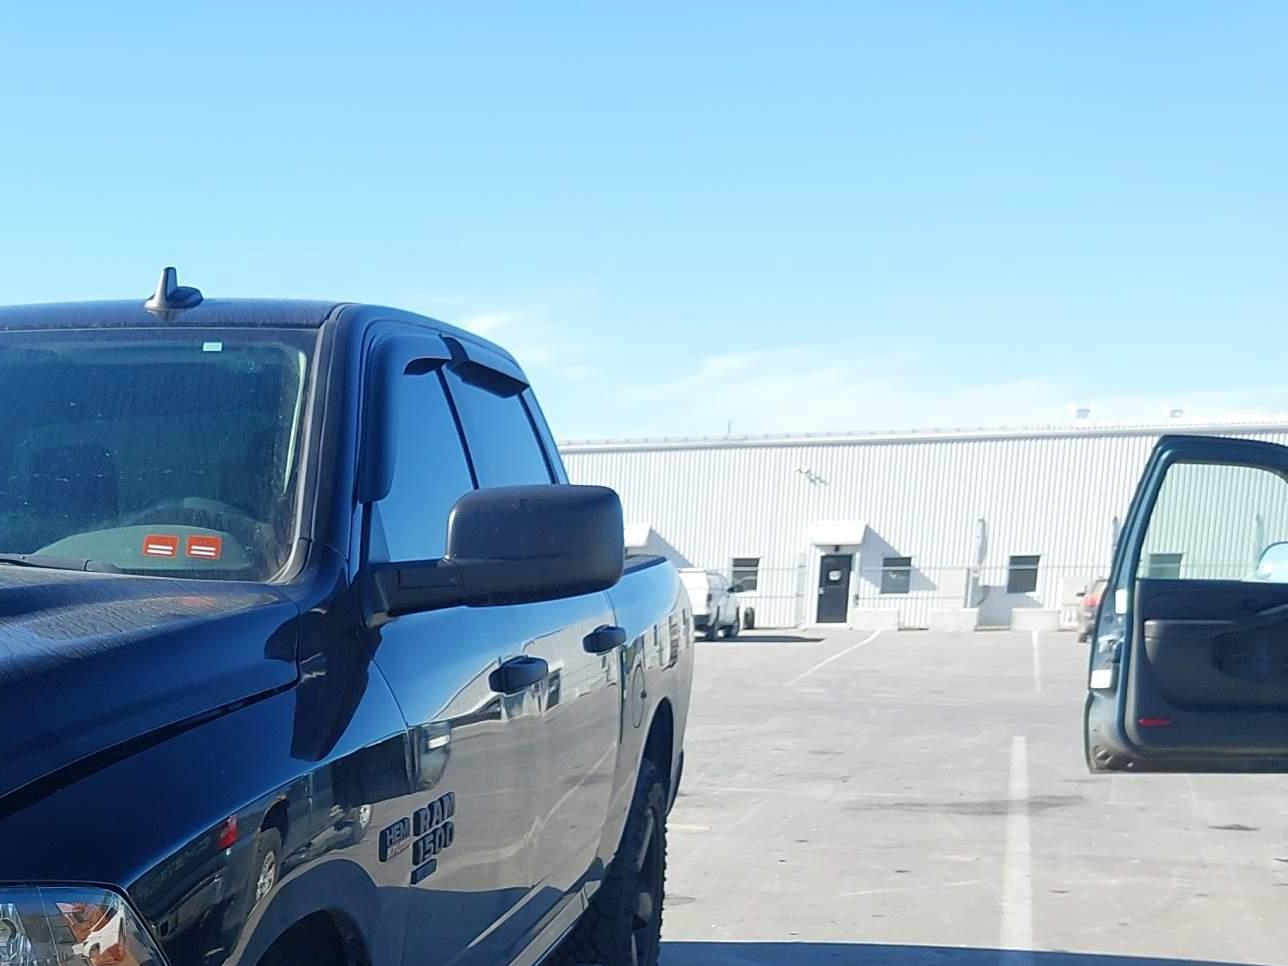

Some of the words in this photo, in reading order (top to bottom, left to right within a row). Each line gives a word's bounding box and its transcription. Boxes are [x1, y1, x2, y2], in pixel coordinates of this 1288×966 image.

[385, 818, 410, 847] HEM
[417, 792, 456, 834] RAM
[417, 821, 455, 864] 1500
